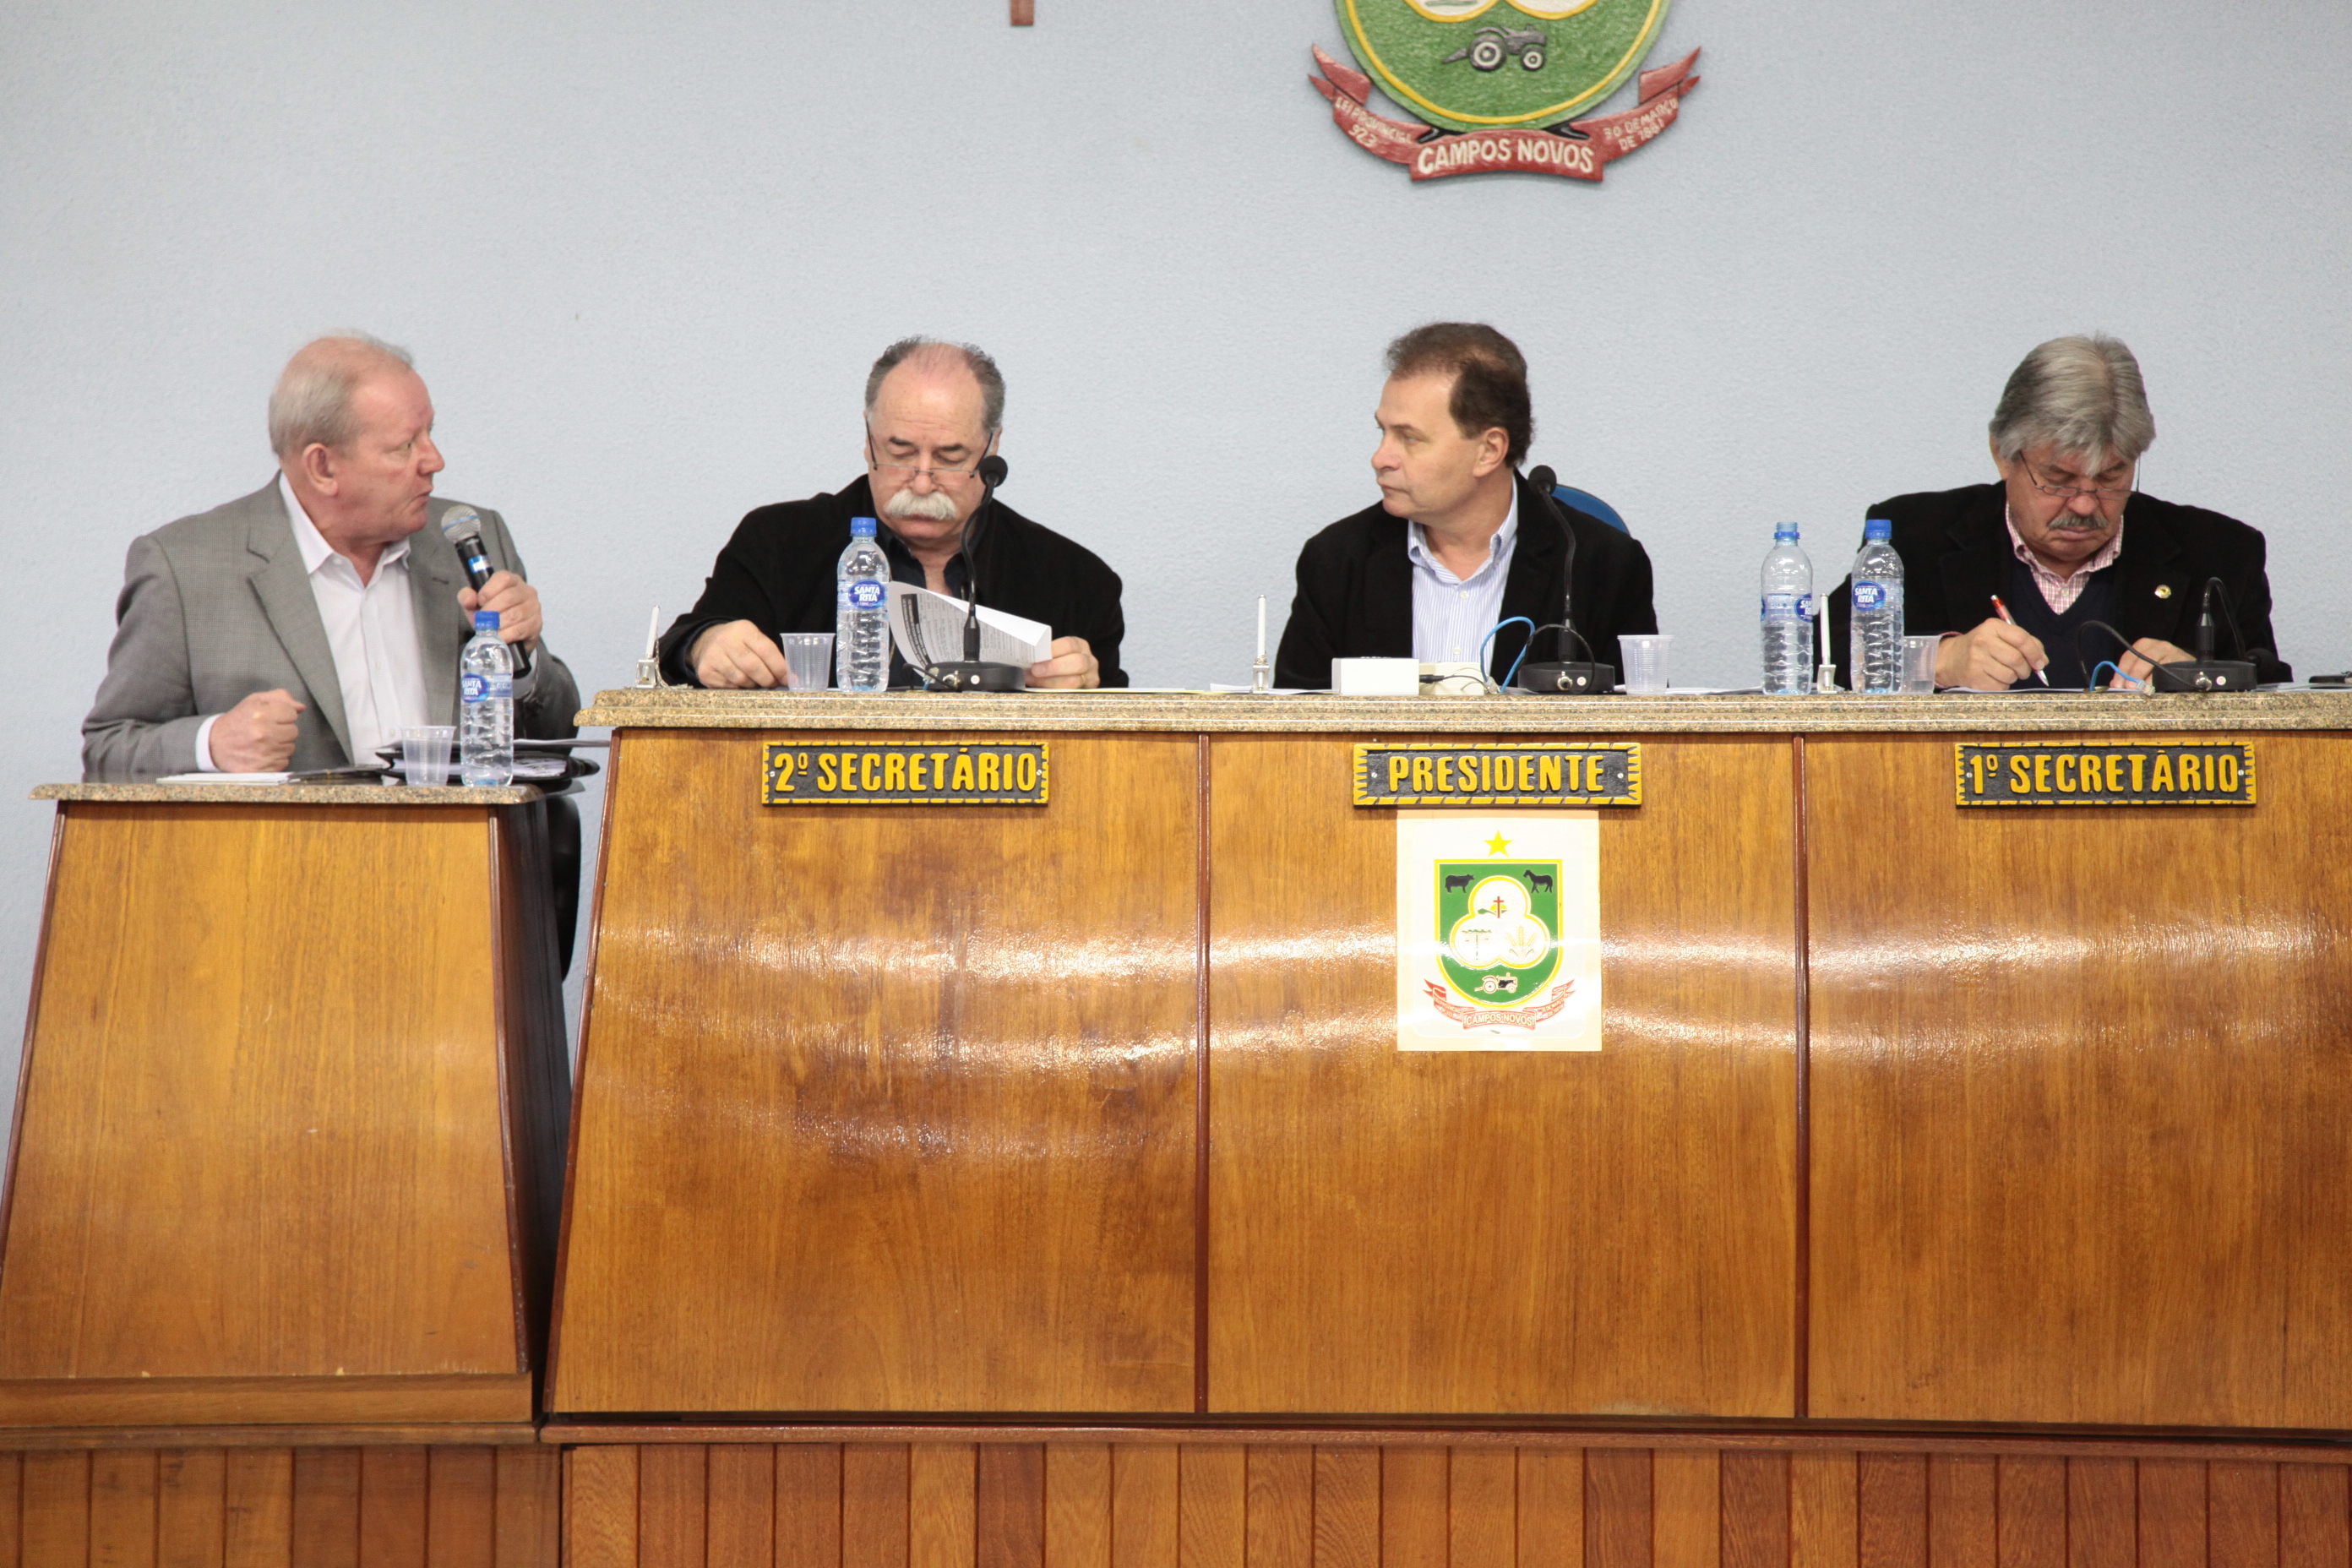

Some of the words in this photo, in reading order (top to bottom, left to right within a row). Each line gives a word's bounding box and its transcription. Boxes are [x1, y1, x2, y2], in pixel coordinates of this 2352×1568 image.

[1624, 117, 1641, 133] DE
[1348, 123, 1377, 147] 923
[1618, 135, 1637, 150] DE
[1418, 138, 1512, 174] CAMPOS
[1517, 139, 1594, 173] NOVOS
[854, 586, 880, 595] SANTA
[859, 593, 878, 602] RITA
[1854, 587, 1878, 596] SANTA
[1857, 595, 1875, 603] RITA
[774, 753, 808, 792] 2º
[817, 748, 1037, 792] SECRETÁRIO
[1389, 755, 1603, 792] PRESIDENTE
[1970, 754, 1999, 794] 1º
[2010, 749, 2239, 793] SECRETÁRIO
[1466, 1013, 1502, 1026] CAMPOS
[1504, 1014, 1533, 1026] NOVOS
